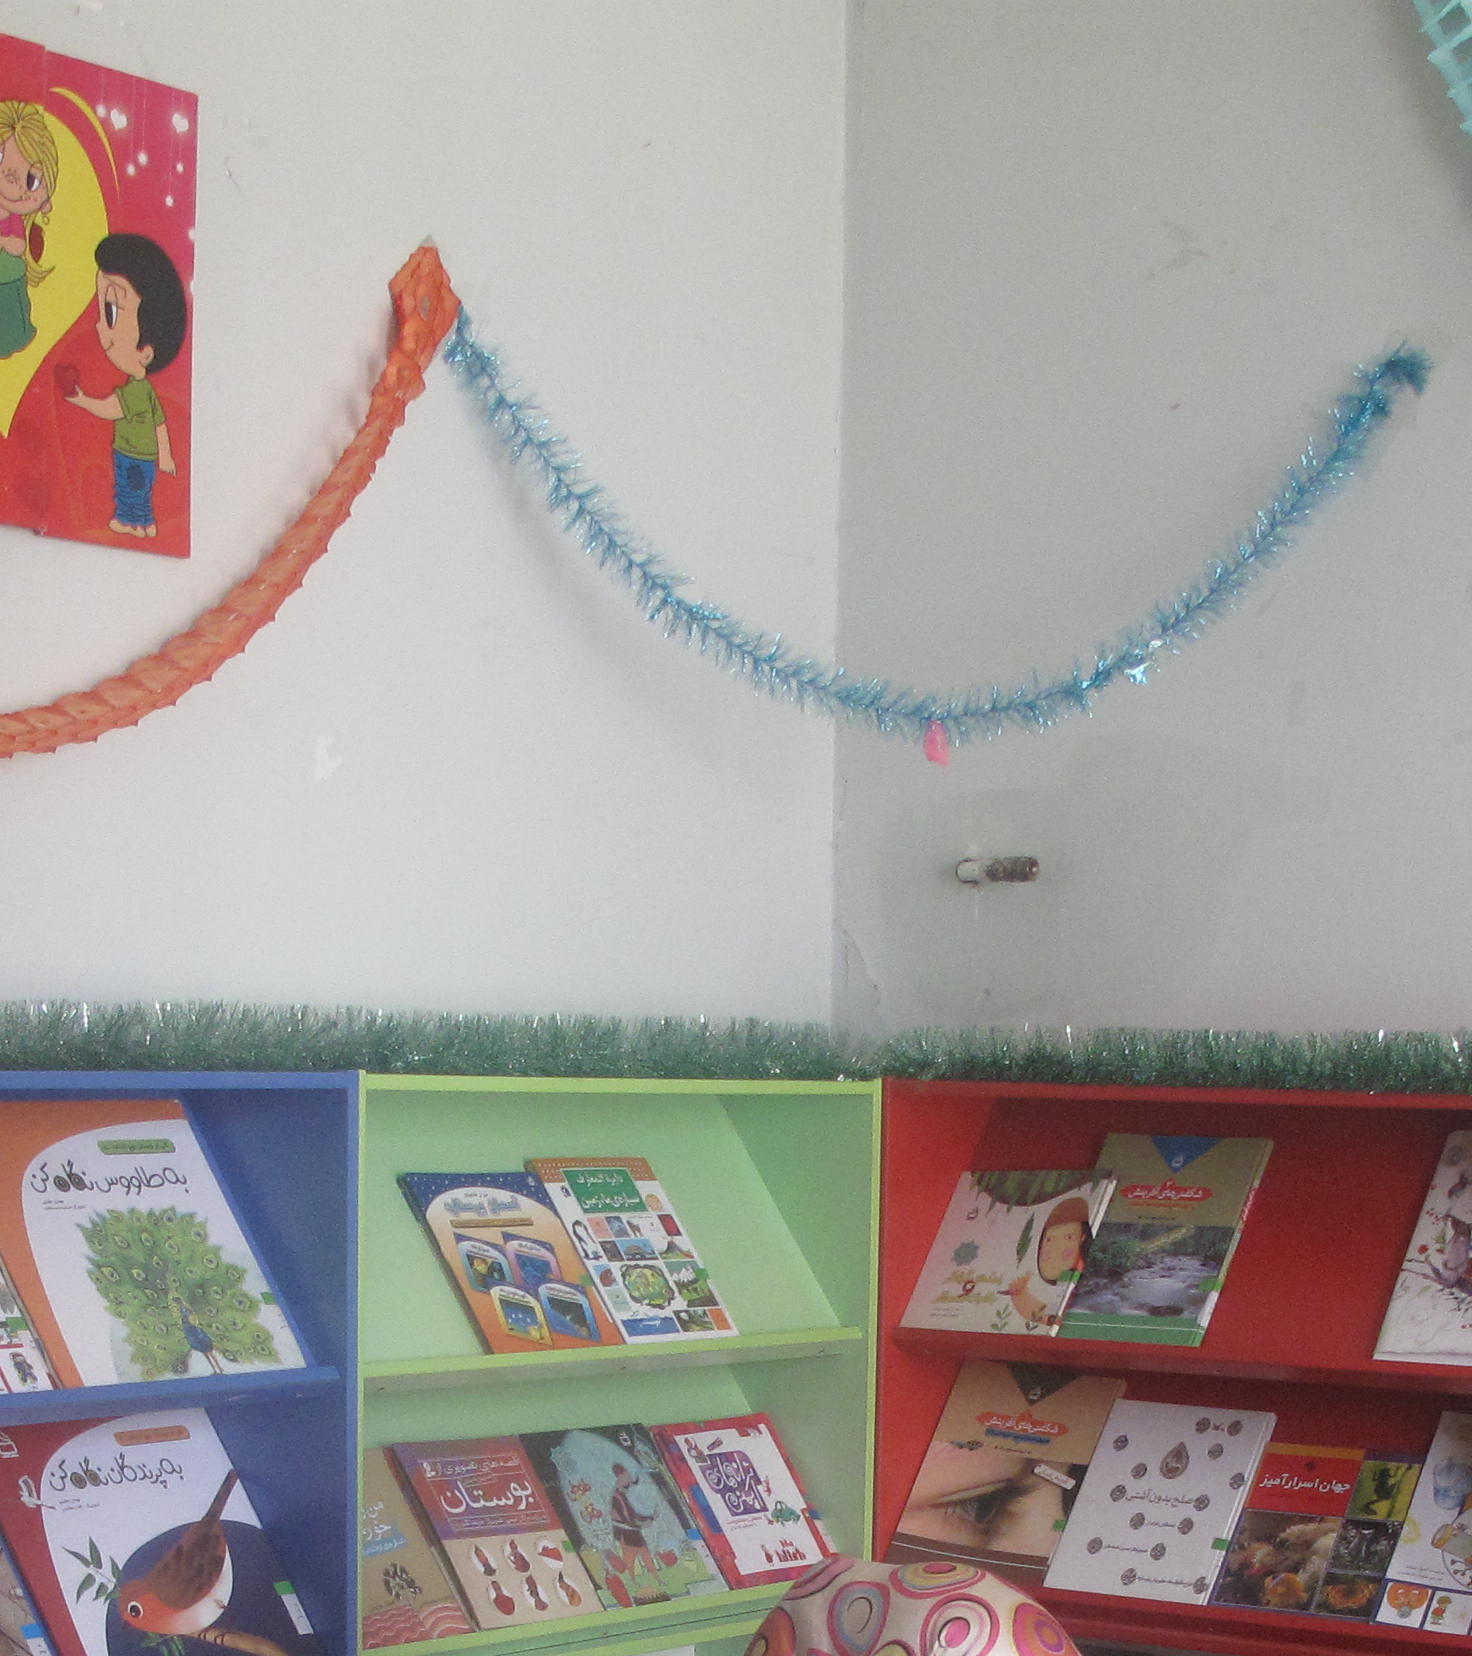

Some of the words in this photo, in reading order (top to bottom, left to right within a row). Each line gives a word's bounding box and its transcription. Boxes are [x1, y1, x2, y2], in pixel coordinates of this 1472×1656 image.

[30, 1162, 50, 1194] کن
[53, 1159, 95, 1192] نگاه
[94, 1166, 165, 1196] طاووس
[162, 1167, 190, 1194] به
[48, 1458, 68, 1492] کن
[69, 1455, 109, 1490] نگاه
[106, 1451, 168, 1489] پرندگان
[160, 1457, 185, 1481] به
[439, 1479, 535, 1514] بوستان
[1318, 1479, 1351, 1494] جهان
